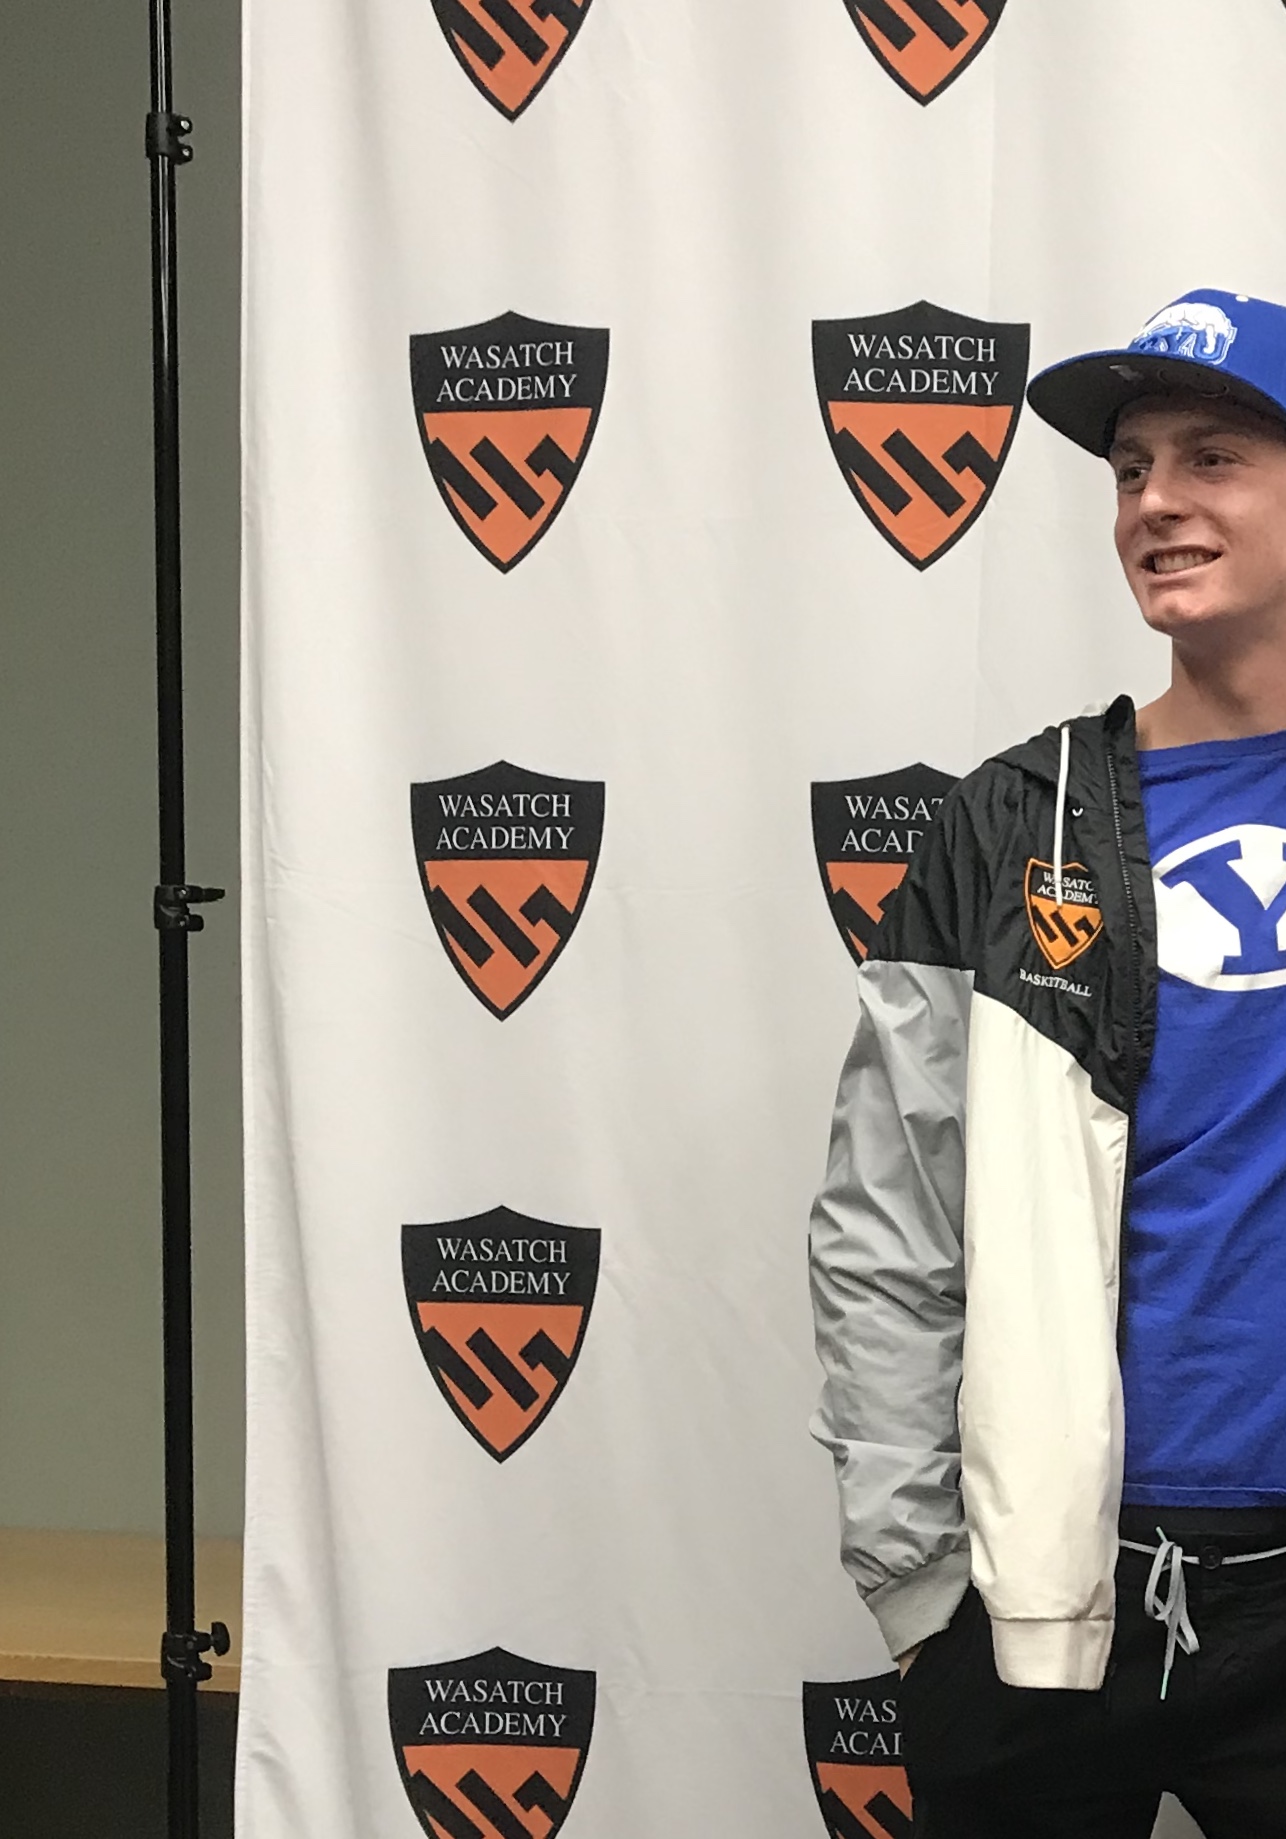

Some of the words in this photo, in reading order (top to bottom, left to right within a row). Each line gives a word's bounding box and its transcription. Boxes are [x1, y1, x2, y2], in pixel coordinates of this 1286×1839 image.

[440, 341, 574, 370] WASATCH
[847, 333, 996, 362] WASATCH
[436, 373, 578, 403] ACADEMY
[843, 367, 999, 396] ACADEMY
[438, 793, 572, 818] WASATCH
[844, 795, 944, 821] WASA
[435, 826, 576, 850] ACADEMY
[1036, 884, 1099, 905] ACDEM
[1042, 871, 1094, 892] WSATC
[436, 1237, 567, 1264] WASATCH
[431, 1269, 571, 1295] ACADEMY
[424, 1679, 563, 1706] WASATCH
[419, 1711, 567, 1738] ACADEMY
